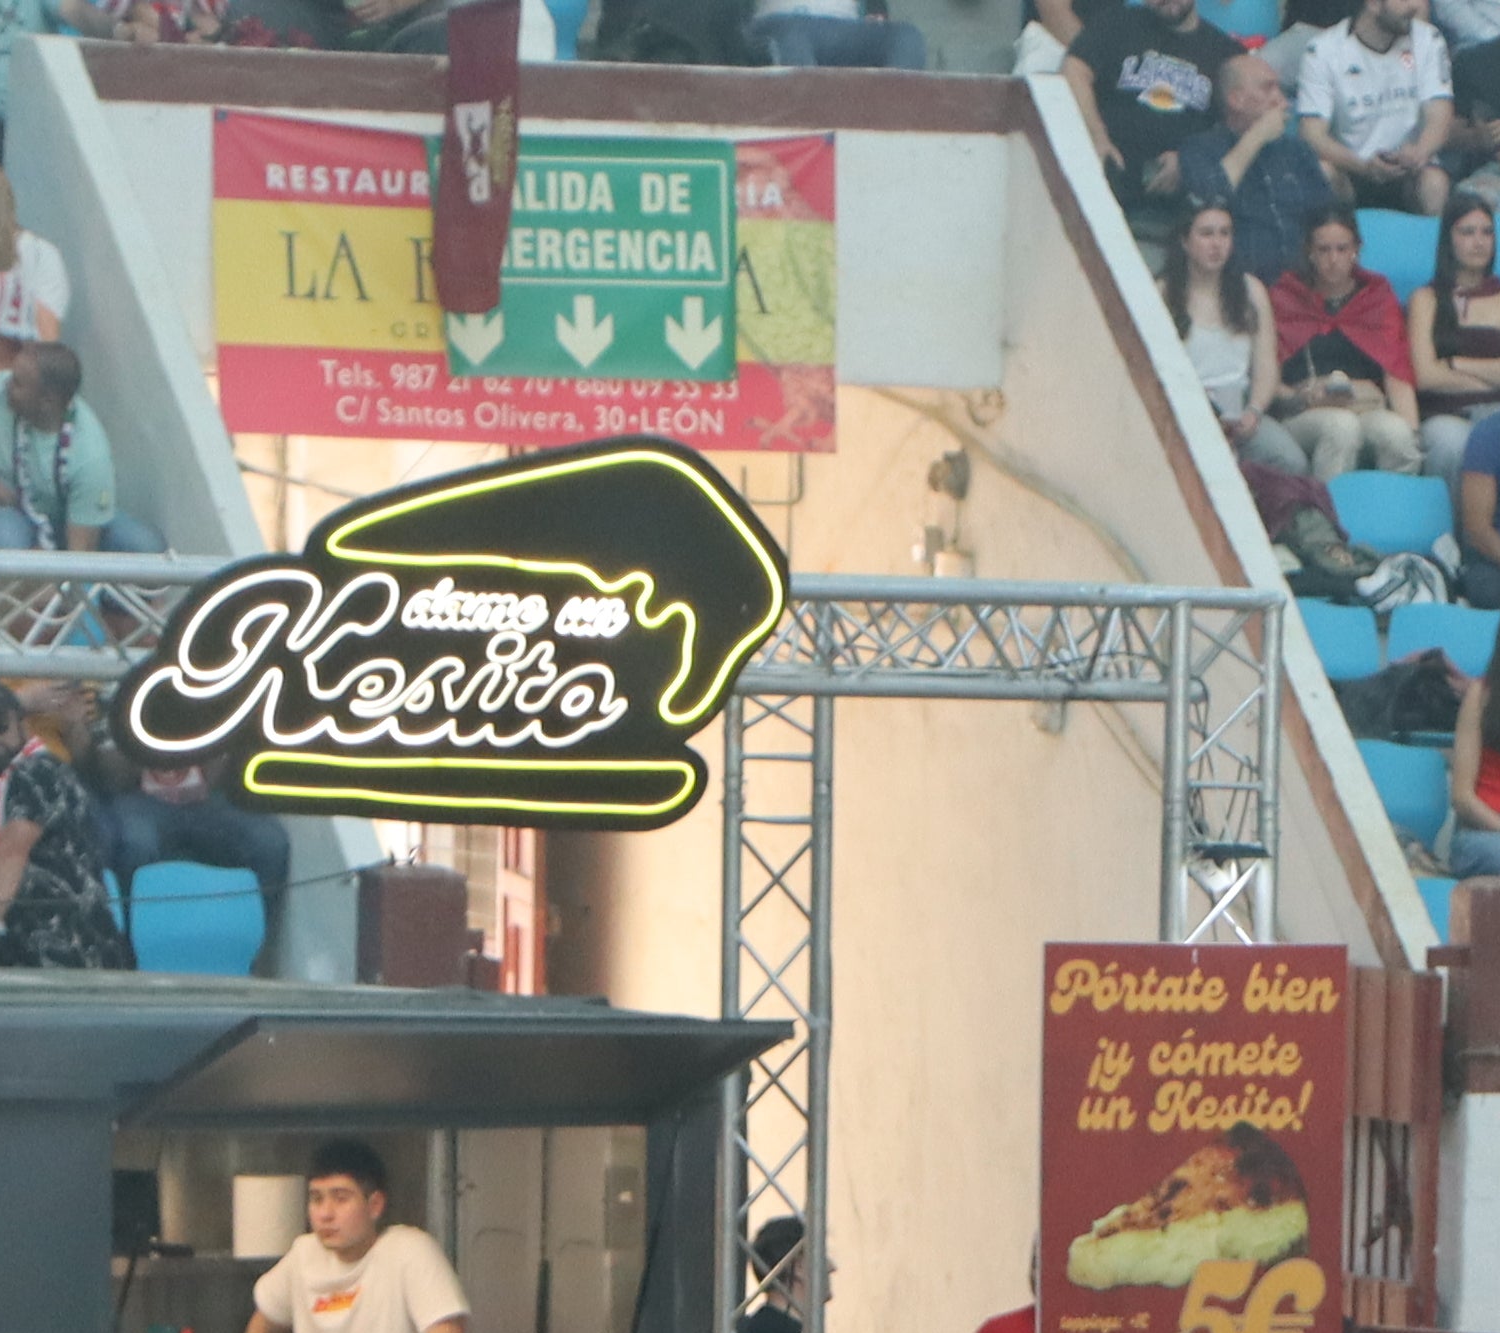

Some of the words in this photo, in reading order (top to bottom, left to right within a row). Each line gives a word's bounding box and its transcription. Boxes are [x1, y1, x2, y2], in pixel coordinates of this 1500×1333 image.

[266, 162, 430, 198] RESTAUR
[640, 173, 692, 214] DE
[279, 229, 369, 302] LA
[502, 226, 717, 273] ERGENCIA
[390, 362, 438, 392] 987
[337, 400, 366, 430] C/
[376, 401, 470, 430] Santos
[130, 570, 629, 750] Kesito
[1051, 958, 1229, 1016] Pórtate
[1242, 961, 1339, 1014] bien
[1087, 1036, 1136, 1093] ¡y
[1148, 1027, 1303, 1077] cómete
[1077, 1088, 1138, 1132] un
[1148, 1079, 1314, 1135] Kesito!
